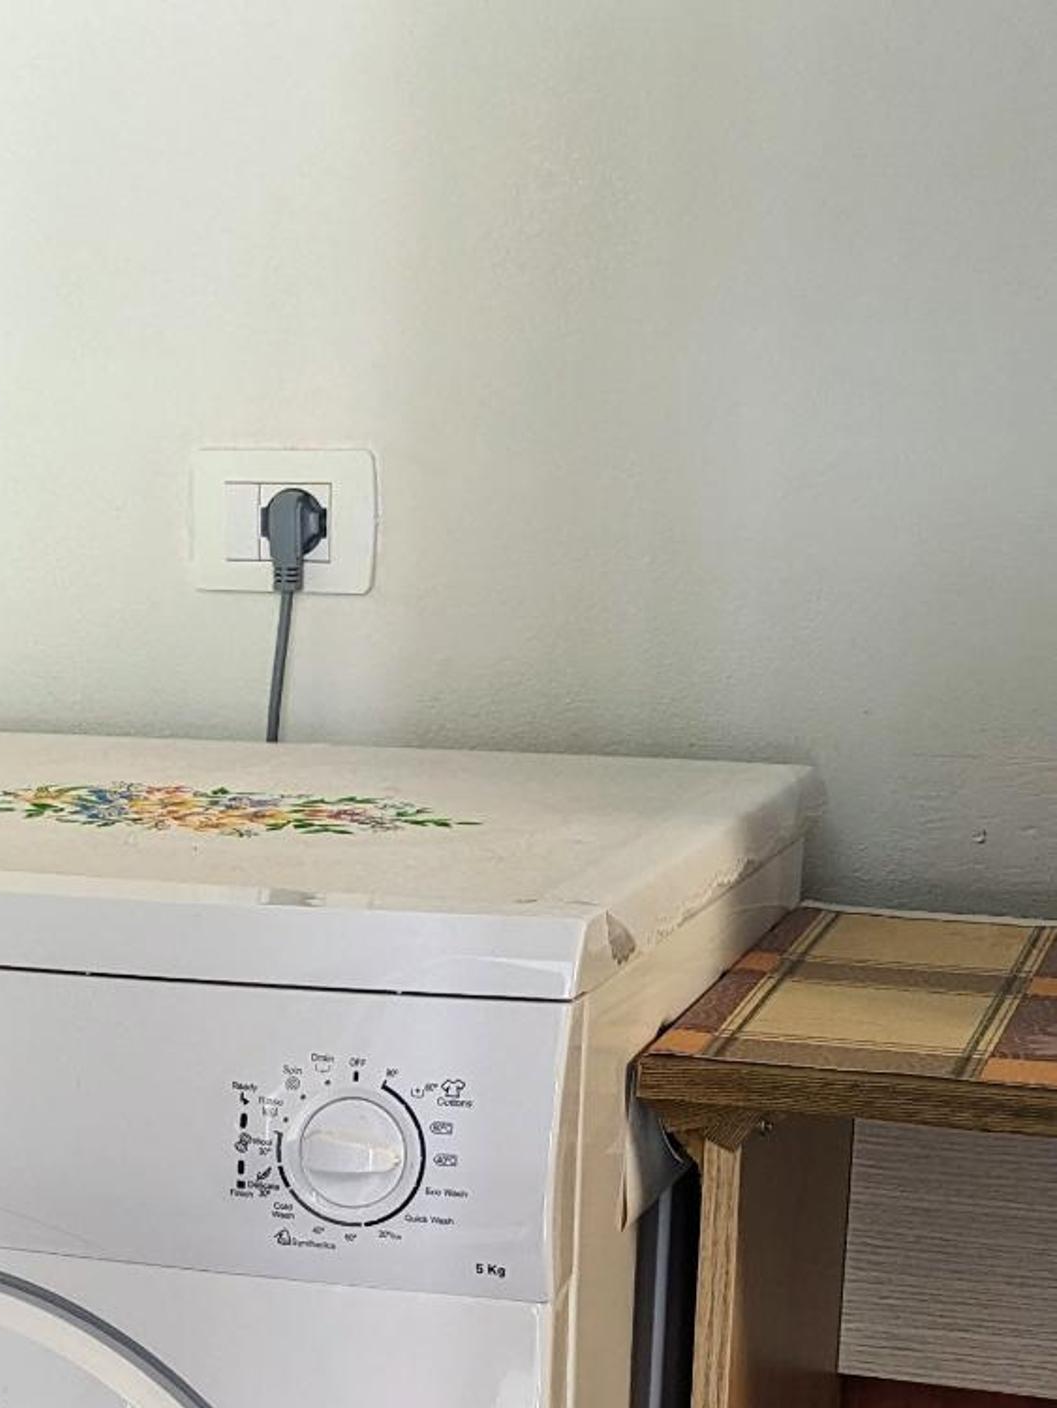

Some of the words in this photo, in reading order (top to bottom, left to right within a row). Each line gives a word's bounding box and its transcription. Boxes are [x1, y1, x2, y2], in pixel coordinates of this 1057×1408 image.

[311, 1053, 334, 1063] Drain
[349, 1058, 367, 1067] OFF
[283, 1065, 303, 1075] Spin
[437, 1097, 473, 1108] Cottons
[444, 1189, 468, 1198] Wash
[405, 1214, 428, 1224] Quick
[430, 1215, 454, 1225] Wash
[475, 1263, 484, 1274] 5
[487, 1264, 506, 1278] Kg
